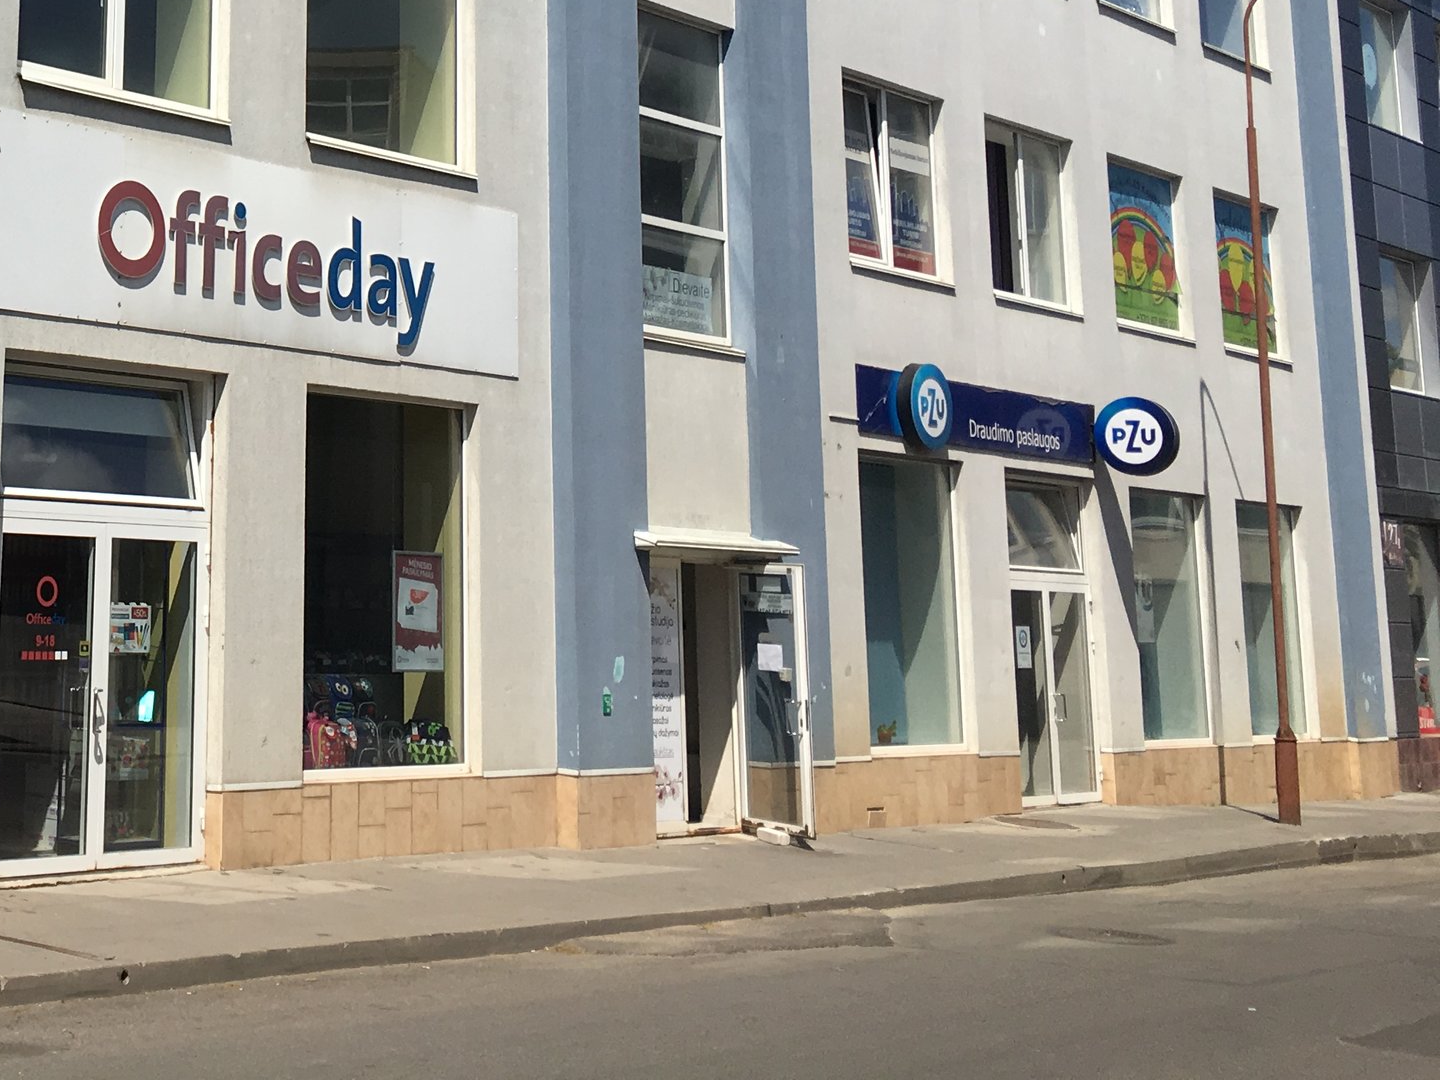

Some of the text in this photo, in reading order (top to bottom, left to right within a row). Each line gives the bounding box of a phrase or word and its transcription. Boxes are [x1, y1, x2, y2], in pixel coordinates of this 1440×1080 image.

[98, 179, 435, 350] Officeday
[920, 387, 945, 429] PZU
[968, 418, 1061, 453] Draudimo paslaugos
[1111, 419, 1156, 454] PZU
[35, 634, 56, 647] 9-18
